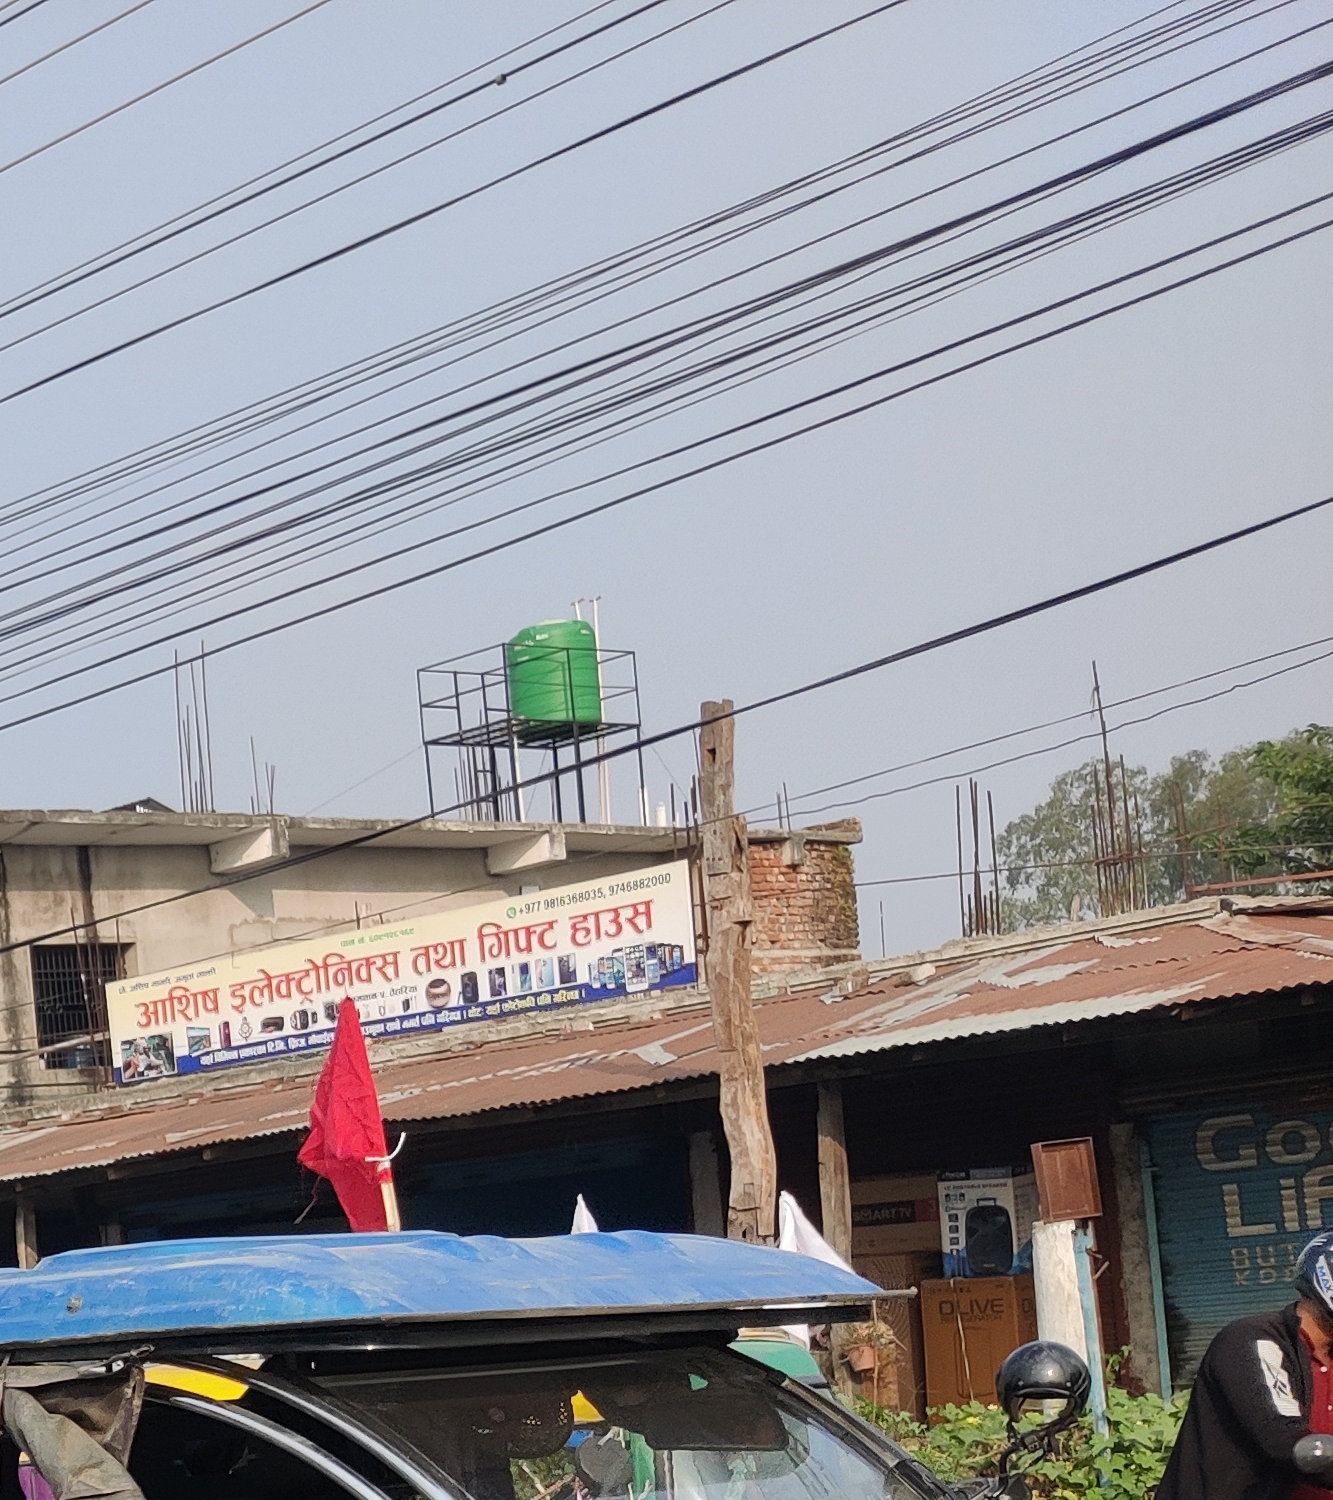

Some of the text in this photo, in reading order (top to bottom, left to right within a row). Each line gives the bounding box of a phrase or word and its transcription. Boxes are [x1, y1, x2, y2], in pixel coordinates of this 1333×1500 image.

[608, 872, 671, 896] 9746882000
[135, 899, 654, 1029] आशिष इलेक्ट्रोनिक्स तथा गिफ्ट हाउस
[899, 1204, 913, 1218] TV
[938, 1299, 1005, 1316] OLIVE
